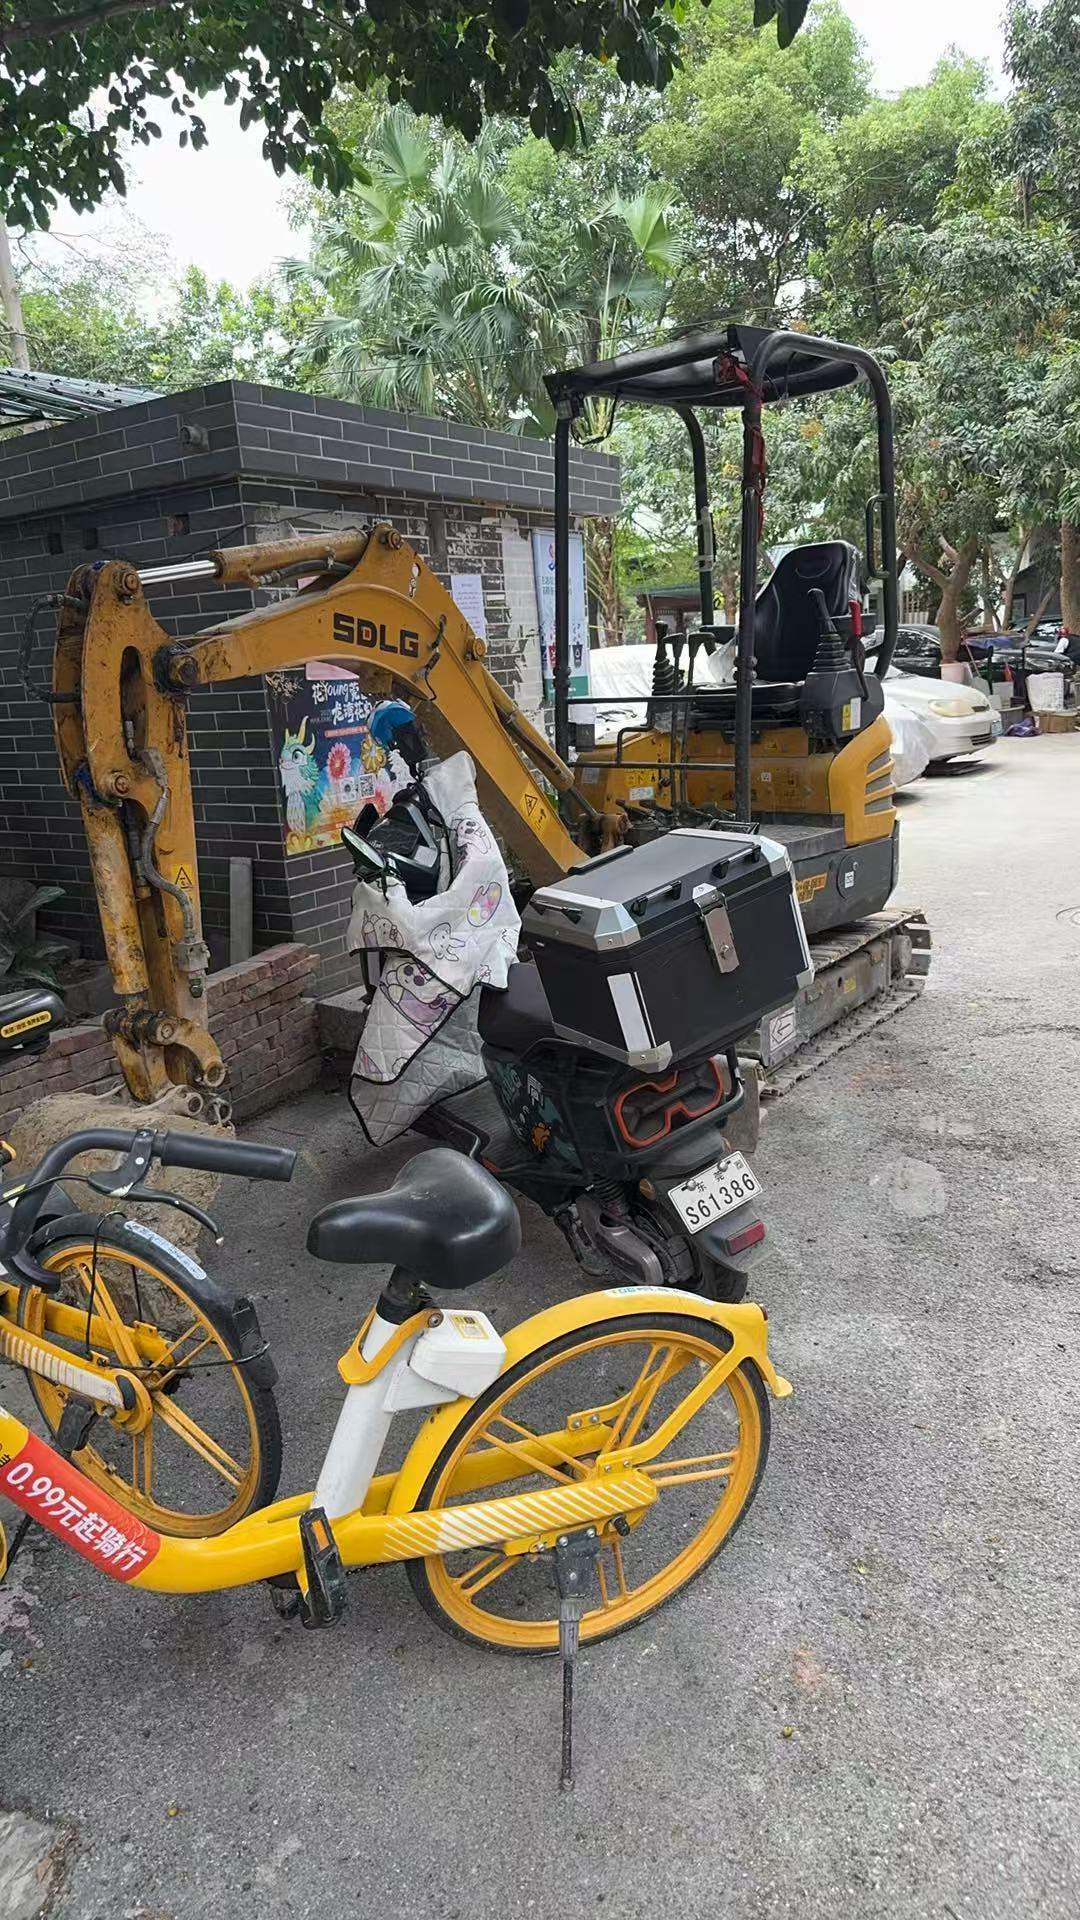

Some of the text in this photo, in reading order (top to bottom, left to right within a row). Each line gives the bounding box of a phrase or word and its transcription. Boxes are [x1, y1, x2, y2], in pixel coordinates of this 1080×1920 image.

[332, 612, 419, 658] SDLG
[685, 1173, 755, 1225] S61386
[6, 1462, 148, 1571] 0.99元起骑行
